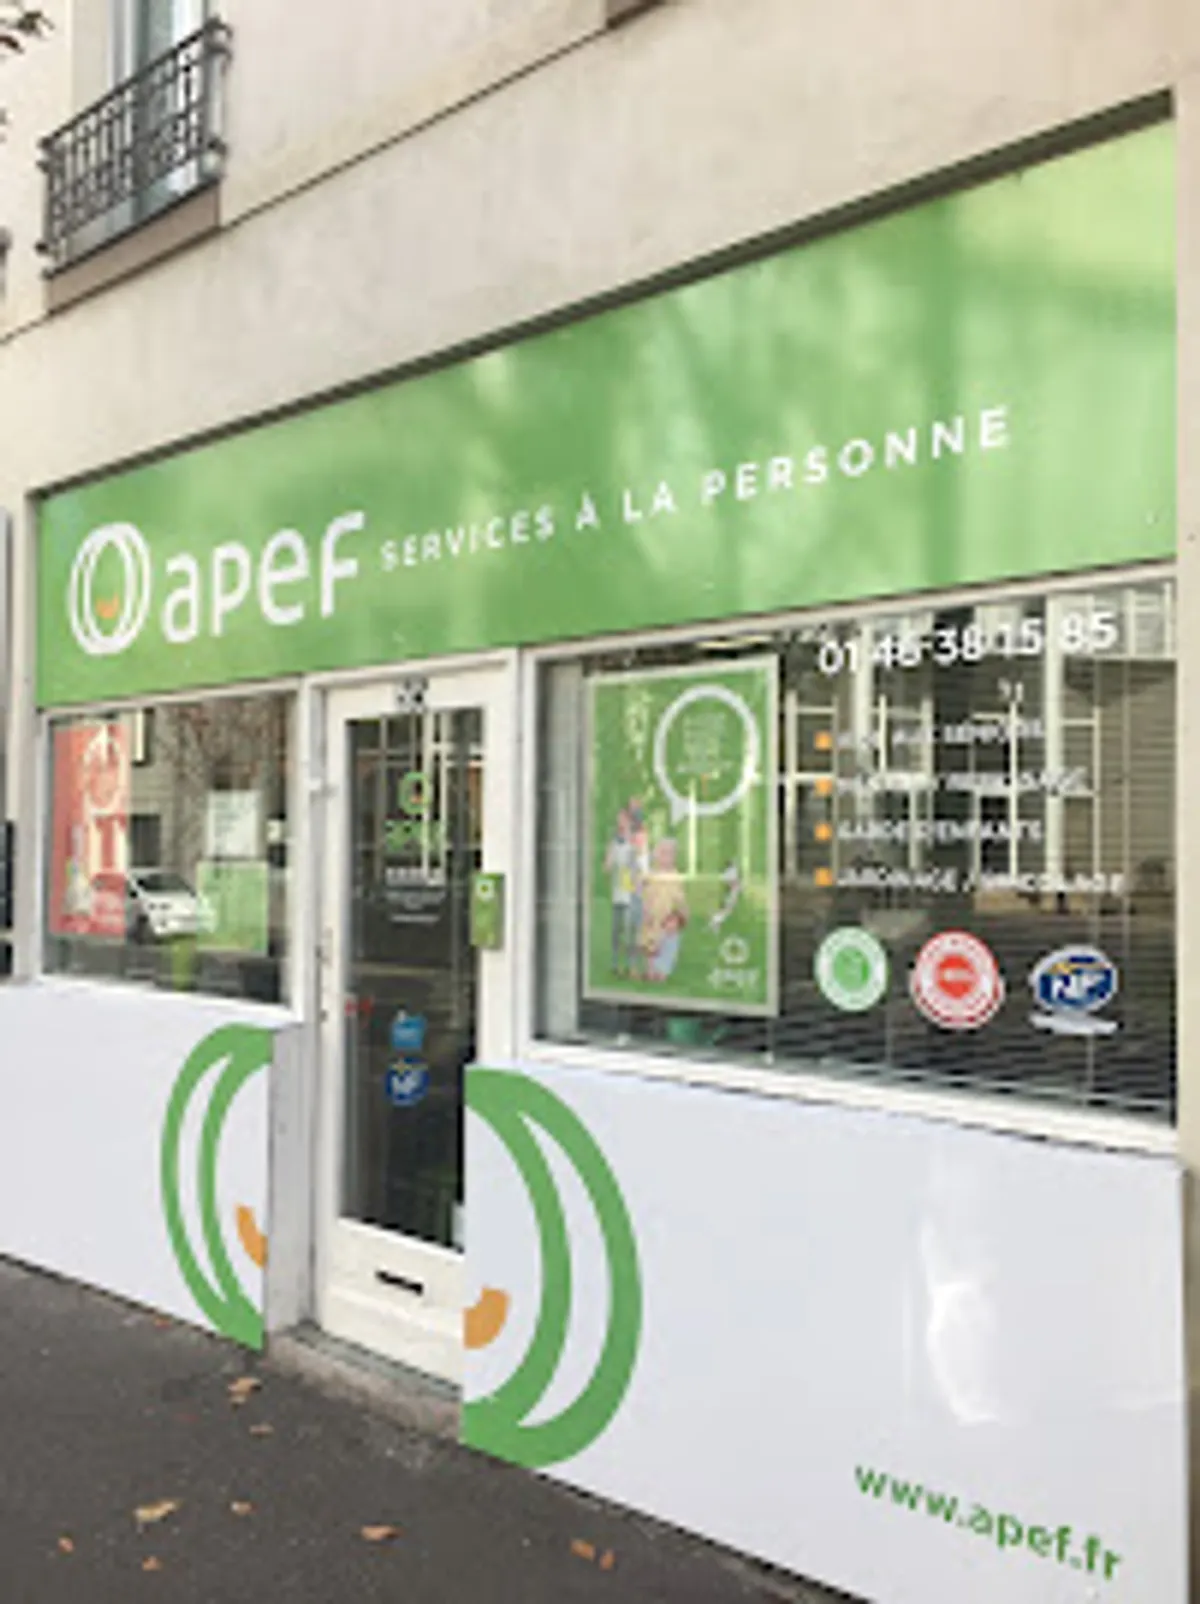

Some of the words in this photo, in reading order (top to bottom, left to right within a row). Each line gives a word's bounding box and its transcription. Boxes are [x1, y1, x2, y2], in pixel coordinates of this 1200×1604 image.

[161, 511, 365, 643] apef
[379, 504, 555, 573] SERVICES
[621, 481, 678, 523] LA
[700, 405, 1009, 505] PERSONNE
[817, 639, 858, 675] 01
[933, 622, 985, 663] 38
[994, 616, 1043, 658] 15
[1058, 611, 1119, 650] 85
[854, 1464, 1123, 1582] www.apef.fr
